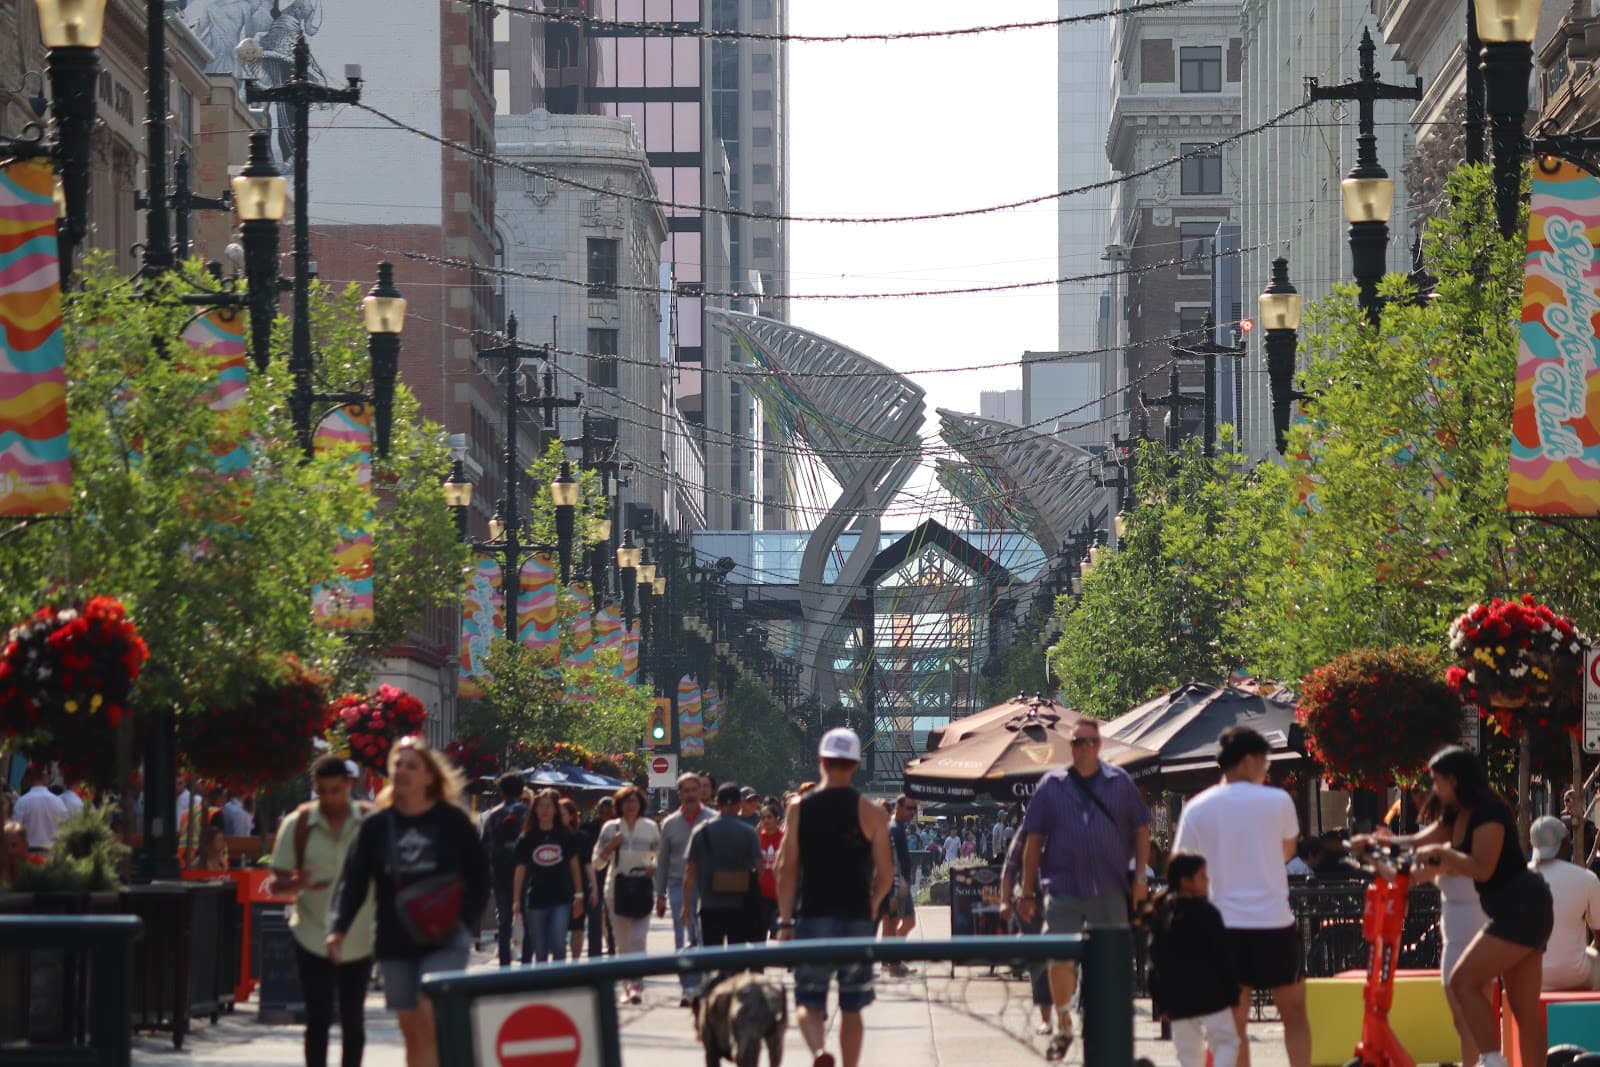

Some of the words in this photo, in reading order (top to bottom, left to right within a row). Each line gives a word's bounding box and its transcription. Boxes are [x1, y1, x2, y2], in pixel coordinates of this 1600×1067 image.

[1541, 217, 1600, 335] Stephen
[1534, 366, 1579, 456] Walk
[1546, 306, 1591, 415] Avenue
